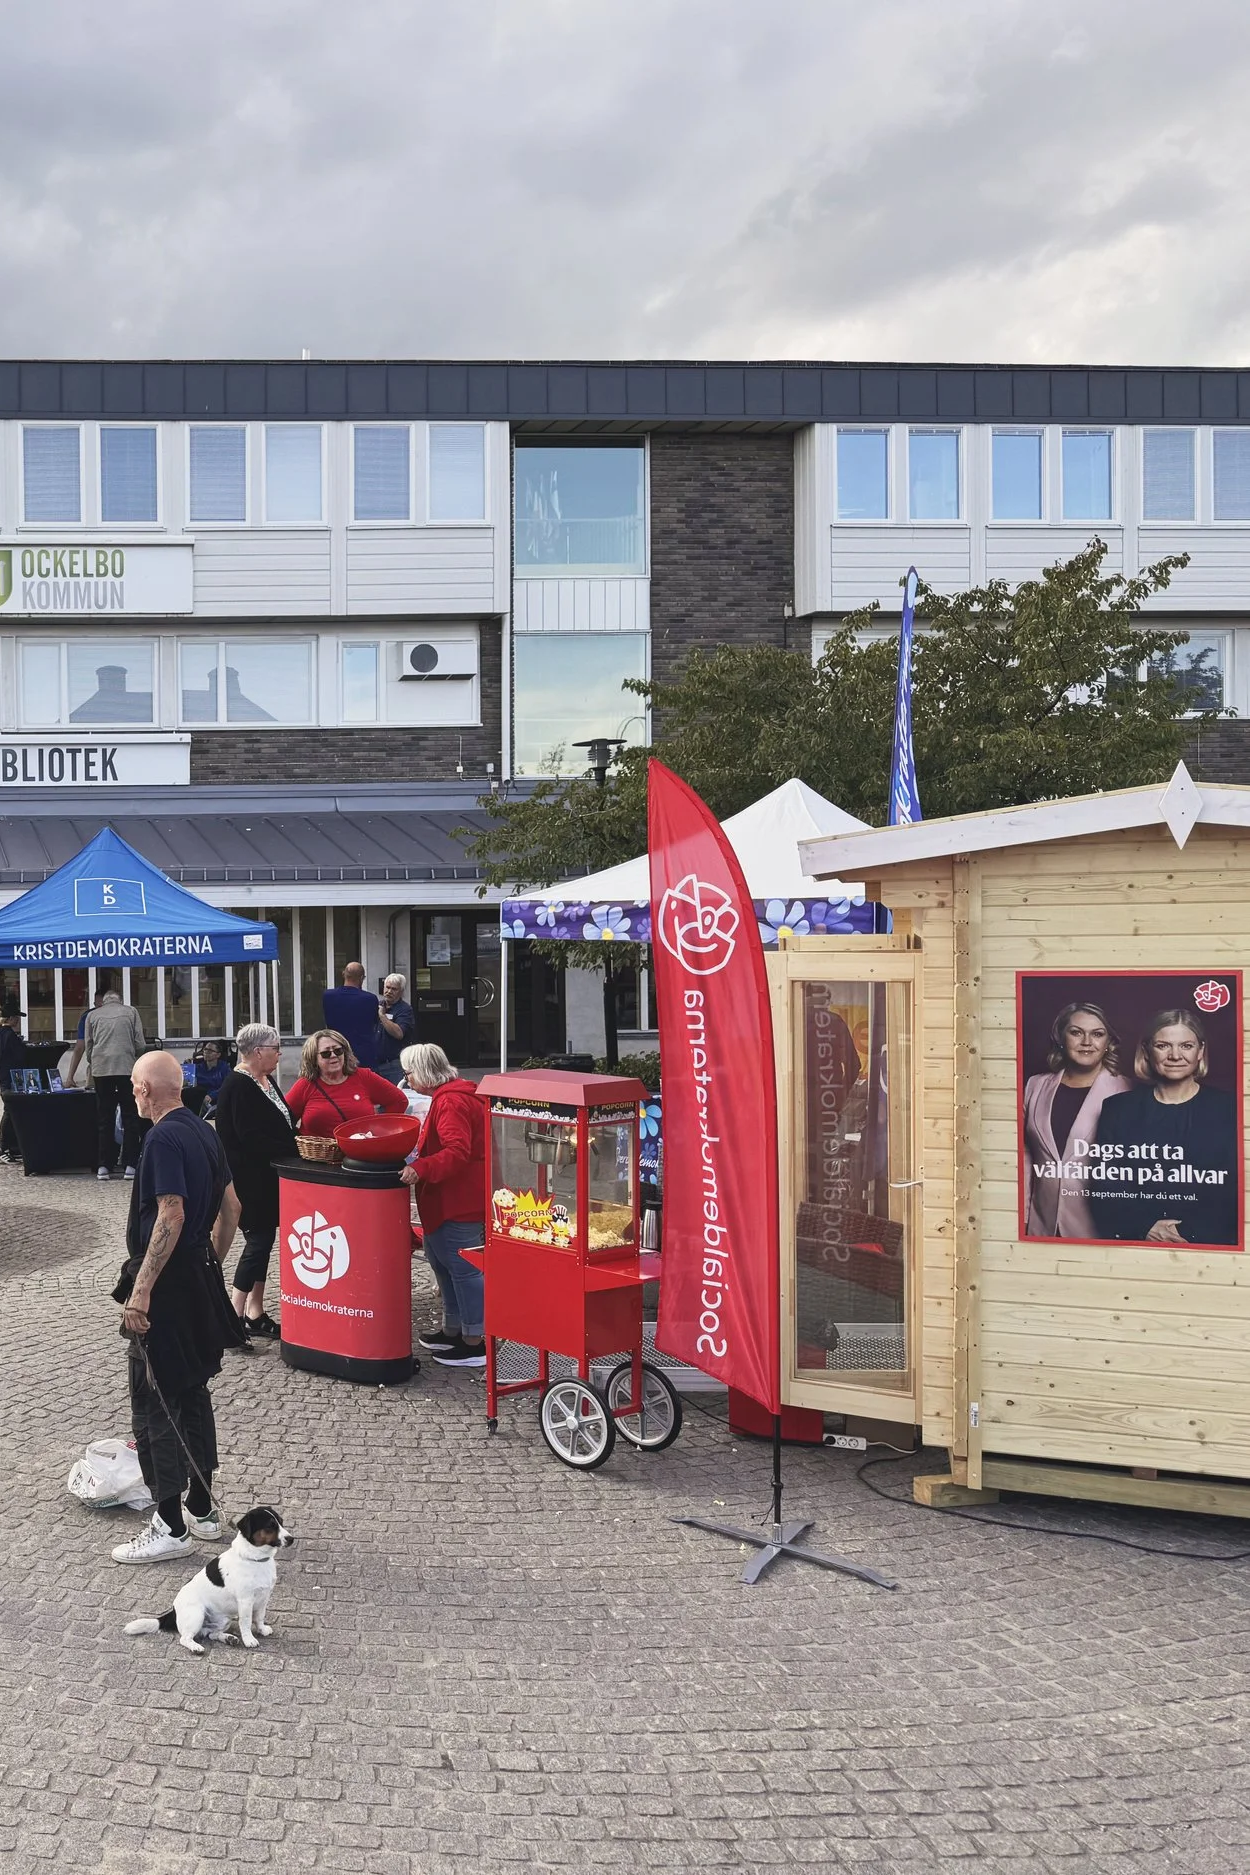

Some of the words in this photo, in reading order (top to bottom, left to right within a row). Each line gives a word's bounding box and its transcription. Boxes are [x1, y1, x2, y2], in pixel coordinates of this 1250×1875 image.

[21, 549, 125, 578] OCKELBO
[22, 581, 124, 609] KOMMUN
[103, 884, 114, 894] K
[103, 896, 116, 905] D
[13, 935, 213, 961] KRISTDEMOKRATERNA
[508, 1097, 550, 1108] POPCORN
[601, 1101, 634, 1110] POPCORN
[1073, 1139, 1124, 1161] Dags
[1128, 1142, 1158, 1160] att
[1162, 1143, 1184, 1160] ta
[1033, 1160, 1133, 1181] välfärden
[1138, 1164, 1163, 1184] på
[1168, 1164, 1228, 1185] allvar
[1061, 1188, 1078, 1197] Den
[1080, 1189, 1090, 1197] 13
[1091, 1191, 1138, 1200] september
[1140, 1191, 1154, 1200] har
[1156, 1191, 1167, 1200] du
[1168, 1193, 1182, 1201] ett
[1183, 1193, 1198, 1201] val.
[504, 1209, 553, 1219] POPCORN
